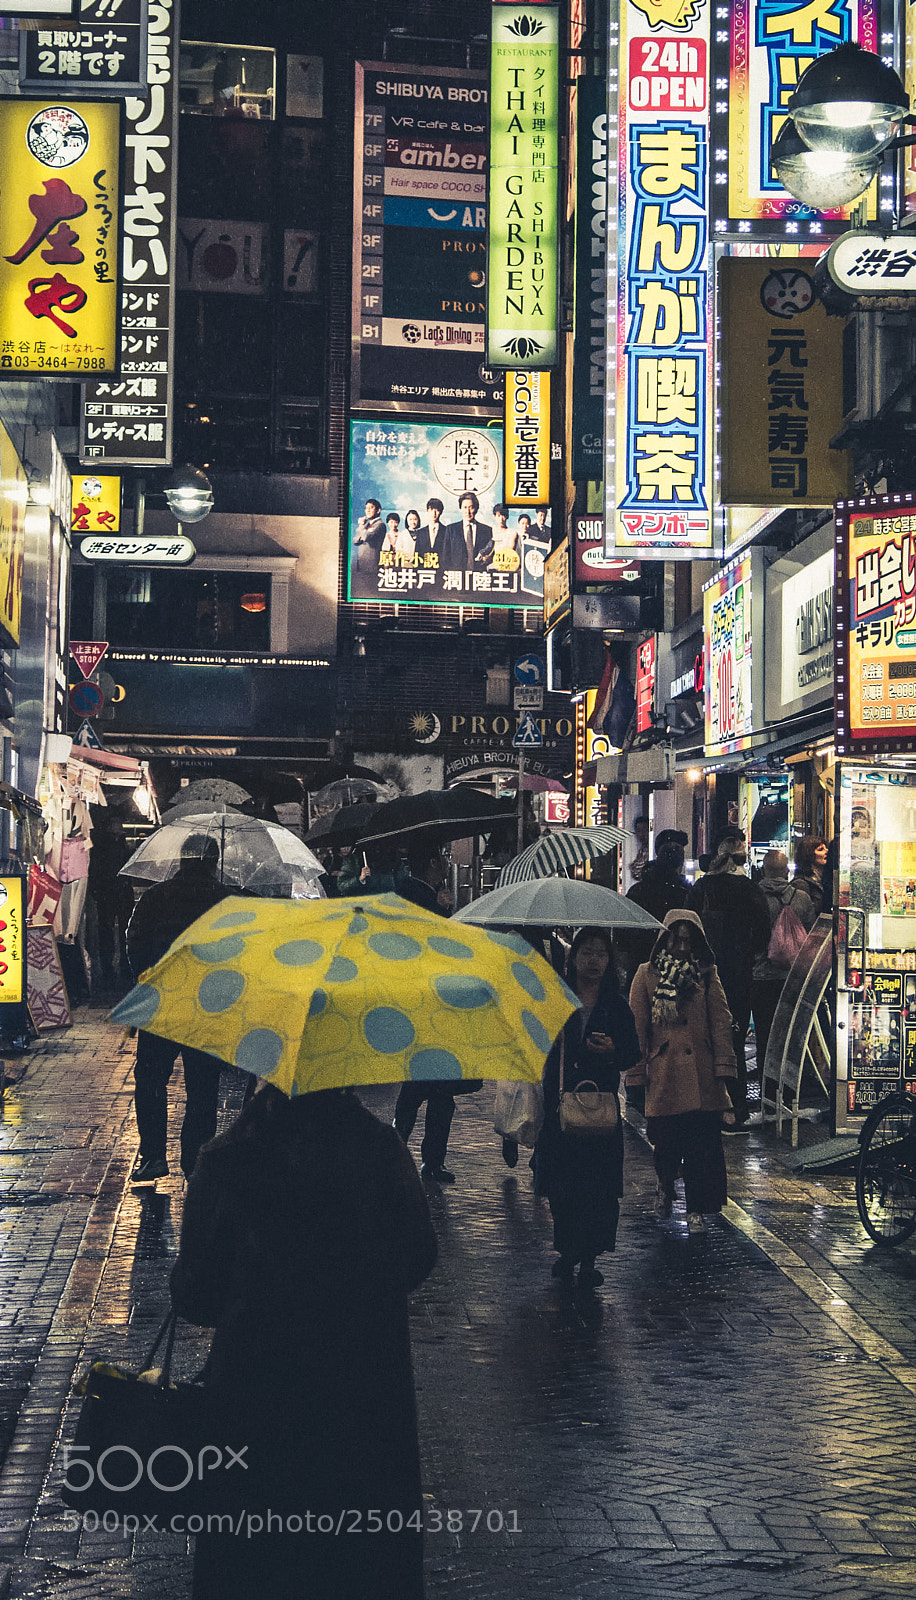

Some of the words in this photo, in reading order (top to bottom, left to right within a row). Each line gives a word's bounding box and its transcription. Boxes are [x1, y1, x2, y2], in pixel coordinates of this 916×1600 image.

[37, 30, 128, 48] 買取りコーナー
[496, 48, 553, 57] RESTAURANT
[641, 41, 698, 73] 24h
[37, 51, 126, 77] 2階です
[375, 81, 444, 100] SHIBUYA
[629, 76, 703, 108] OPEN
[364, 113, 383, 127] 7F
[391, 116, 414, 128] VR
[417, 119, 447, 130] cafe
[450, 121, 461, 131] &
[532, 66, 546, 184] タイ料理専門店
[364, 144, 382, 157] 6F
[399, 143, 487, 170] amber
[364, 174, 382, 187] 5F
[391, 178, 409, 187] Hair
[411, 181, 438, 190] space
[441, 181, 471, 192] COCO
[363, 205, 381, 218] 4F
[363, 235, 380, 248] 3F
[847, 246, 916, 278] 渋谷
[362, 265, 380, 277] 2F
[363, 295, 380, 307] 1F
[633, 127, 702, 503] まんが喫茶
[362, 324, 379, 338] B1
[446, 326, 472, 345] Dining
[2, 341, 47, 354] 渋谷店
[14, 356, 106, 369] 03-3464-7988
[391, 384, 430, 396] 渋谷エリア
[767, 328, 809, 498] 元気寿司
[87, 420, 164, 442] レディース服
[453, 439, 480, 493] 陸王
[621, 515, 708, 538] マンボー
[85, 541, 185, 557] 渋谷センター街
[378, 551, 440, 569] 原作小説
[377, 567, 436, 593] 池井戸
[75, 645, 102, 655] 止まれ
[79, 654, 98, 664] STOP
